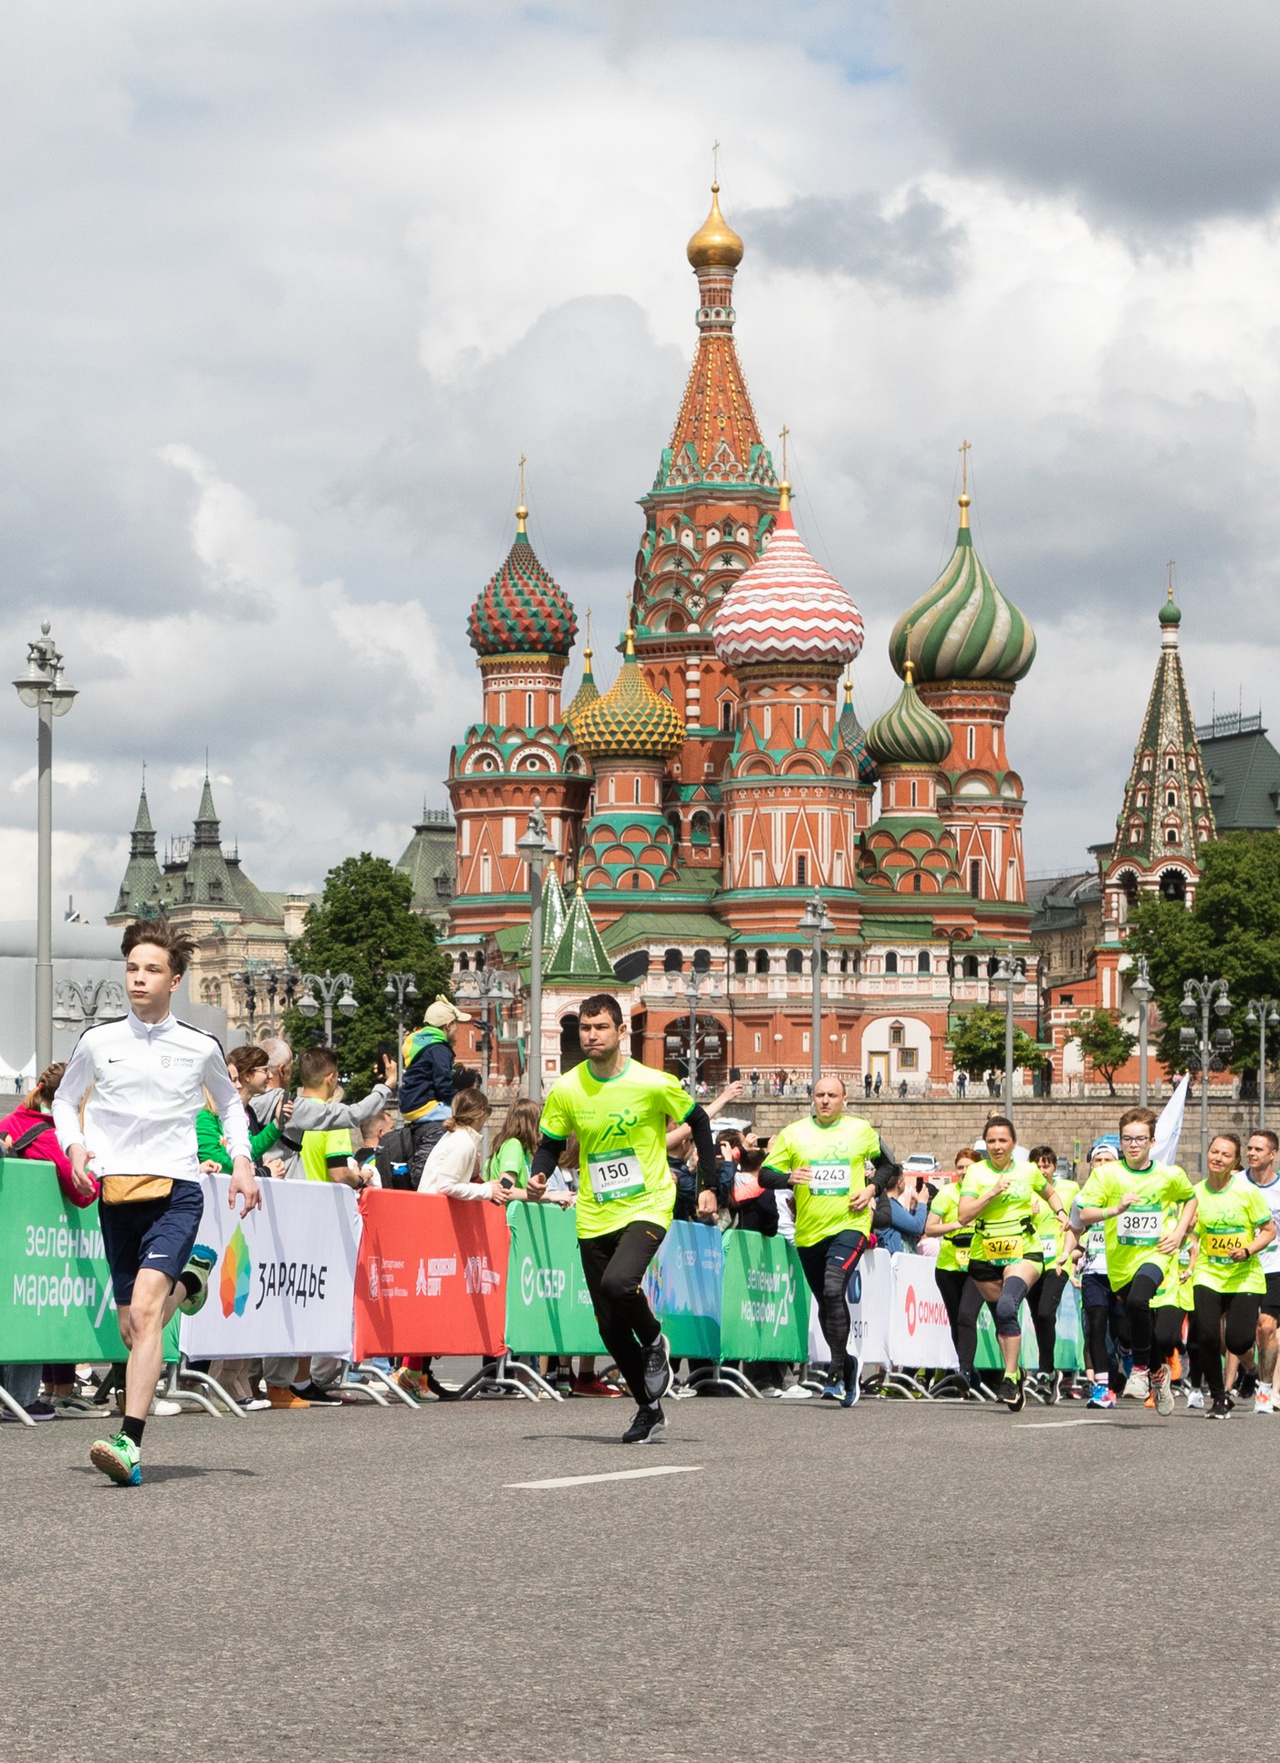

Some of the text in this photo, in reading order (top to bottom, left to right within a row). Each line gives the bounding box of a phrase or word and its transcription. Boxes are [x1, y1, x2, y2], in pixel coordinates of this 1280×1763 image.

[598, 1162, 629, 1181] 150
[814, 1169, 845, 1181] 4243
[1123, 1216, 1157, 1229] 3873
[25, 1214, 106, 1260] зелёный
[988, 1240, 1017, 1252] 3727
[1092, 1234, 1105, 1243] 46
[1211, 1237, 1242, 1250] 2466
[13, 1262, 97, 1317] марафон
[255, 1262, 328, 1310] ЗАРЯДЬЕ
[536, 1268, 565, 1298] СБЕР
[747, 1262, 780, 1293] зелёный
[740, 1294, 776, 1328] марафон
[918, 1300, 949, 1326] самока
[849, 1320, 869, 1345] yson
